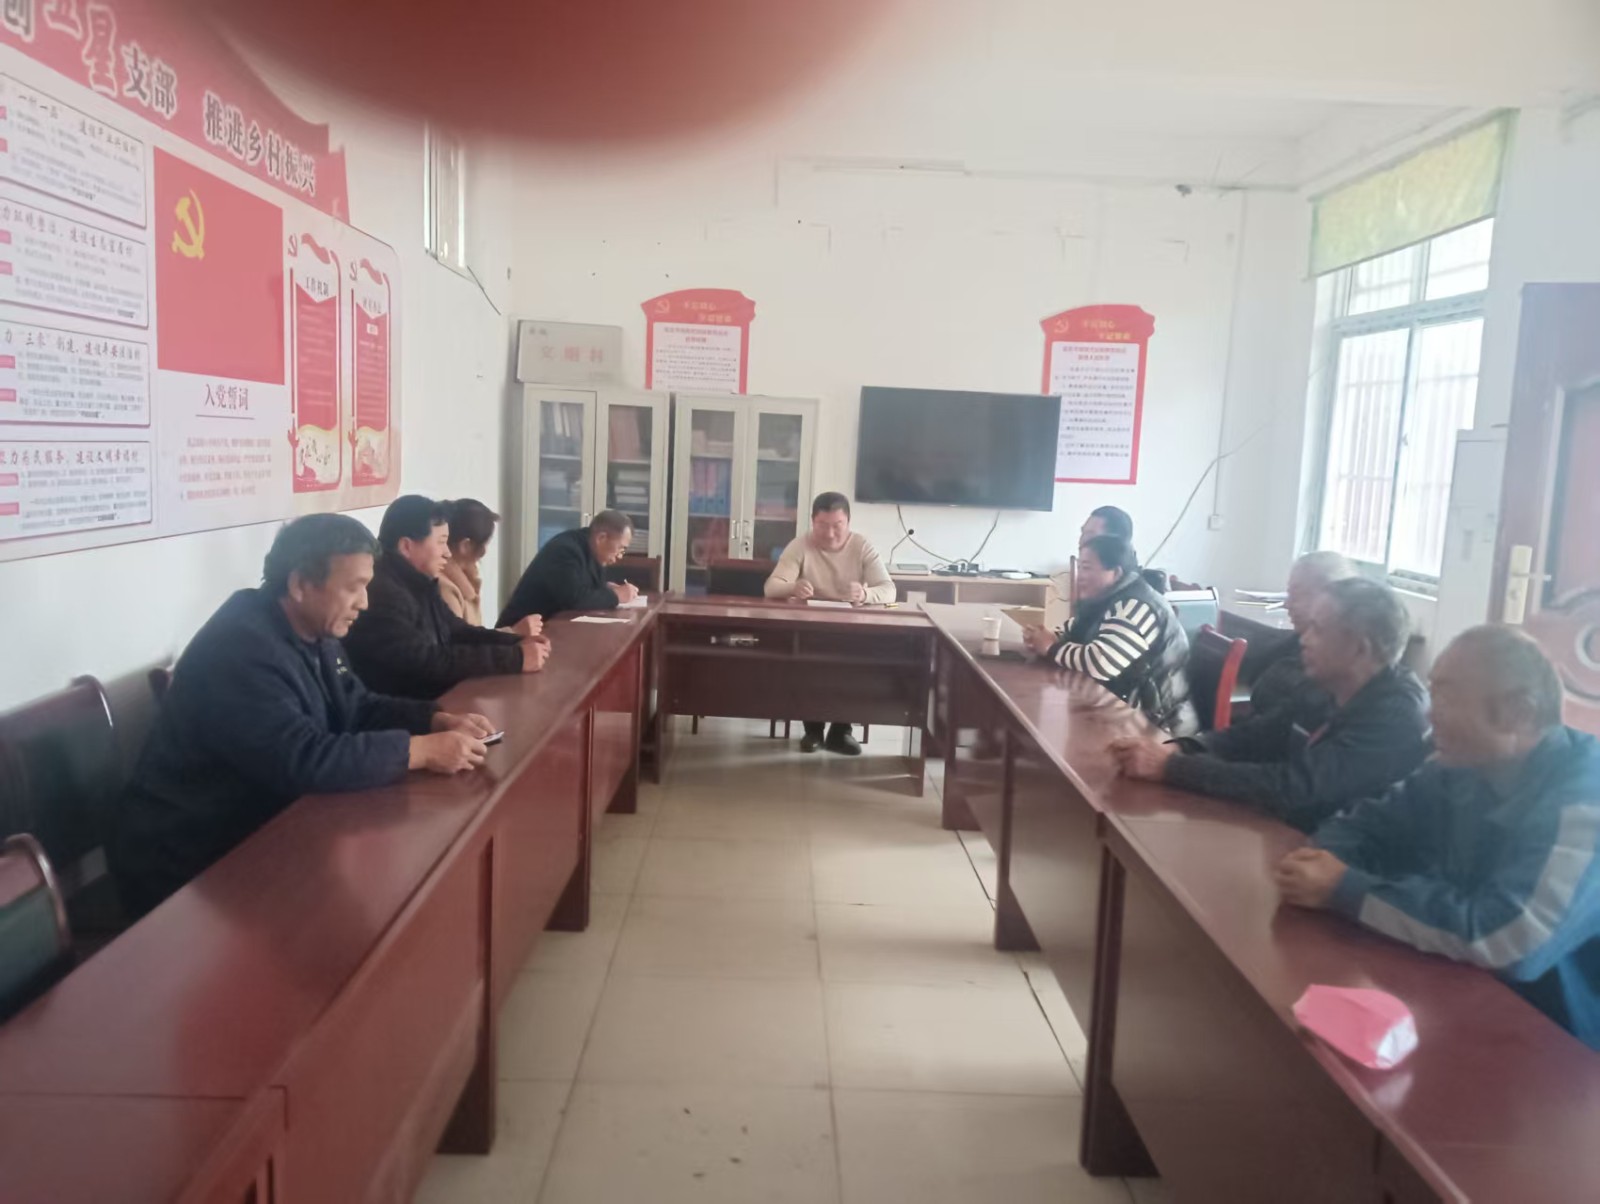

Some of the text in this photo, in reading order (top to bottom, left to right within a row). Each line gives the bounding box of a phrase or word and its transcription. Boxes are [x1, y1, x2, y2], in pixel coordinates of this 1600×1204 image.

[203, 90, 316, 196] 推进乡村振兴
[204, 383, 249, 411] 入党誓词
